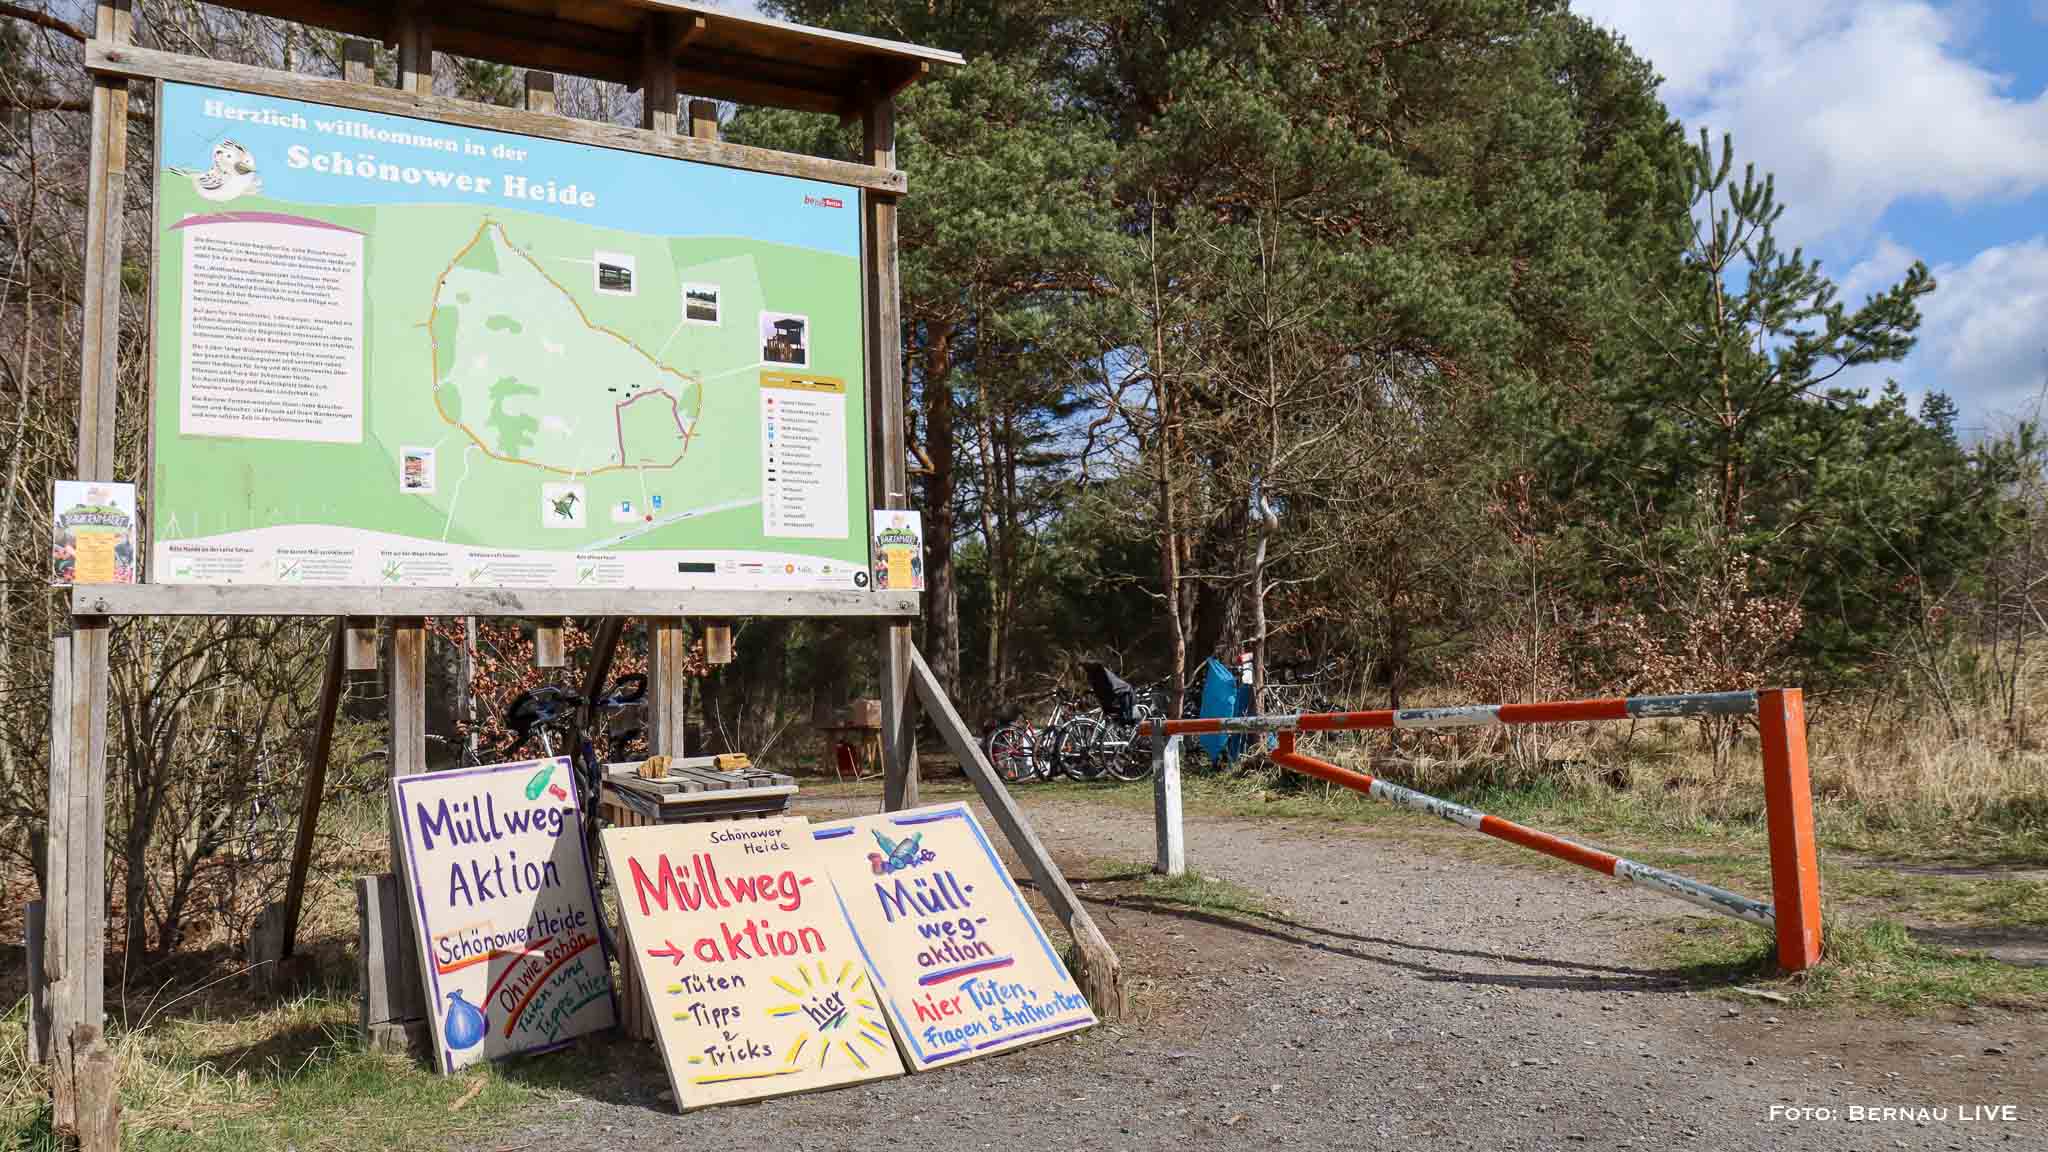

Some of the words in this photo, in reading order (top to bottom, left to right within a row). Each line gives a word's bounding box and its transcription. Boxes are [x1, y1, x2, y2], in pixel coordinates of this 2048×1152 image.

[203, 99, 307, 130] Herzlich
[314, 119, 459, 153] willkommen
[464, 137, 486, 157] in
[491, 143, 529, 162] der
[287, 144, 493, 194] Schönower
[504, 173, 598, 209] Heide
[417, 791, 574, 851] Müllweg-
[744, 839, 790, 854] Heide
[449, 850, 561, 907] Aktion
[628, 853, 814, 916] Müllweg-
[439, 924, 534, 965] Schönower
[535, 904, 587, 937] Heide
[693, 920, 827, 963] aktion
[918, 917, 988, 940] weg-
[500, 983, 524, 1013] Oh
[519, 956, 542, 987] wie
[543, 927, 587, 965] schön
[551, 957, 585, 987] und
[917, 938, 994, 968] aktion
[680, 973, 746, 995] Tüten
[912, 993, 962, 1023] hier
[959, 977, 1037, 1012] Tüten,
[688, 1001, 741, 1029] Tipps
[802, 990, 846, 1025] hier
[923, 1020, 988, 1048] Fragen
[988, 1013, 1002, 1031] &
[1002, 991, 1088, 1027] Antworten
[704, 1039, 773, 1067] Tricks
